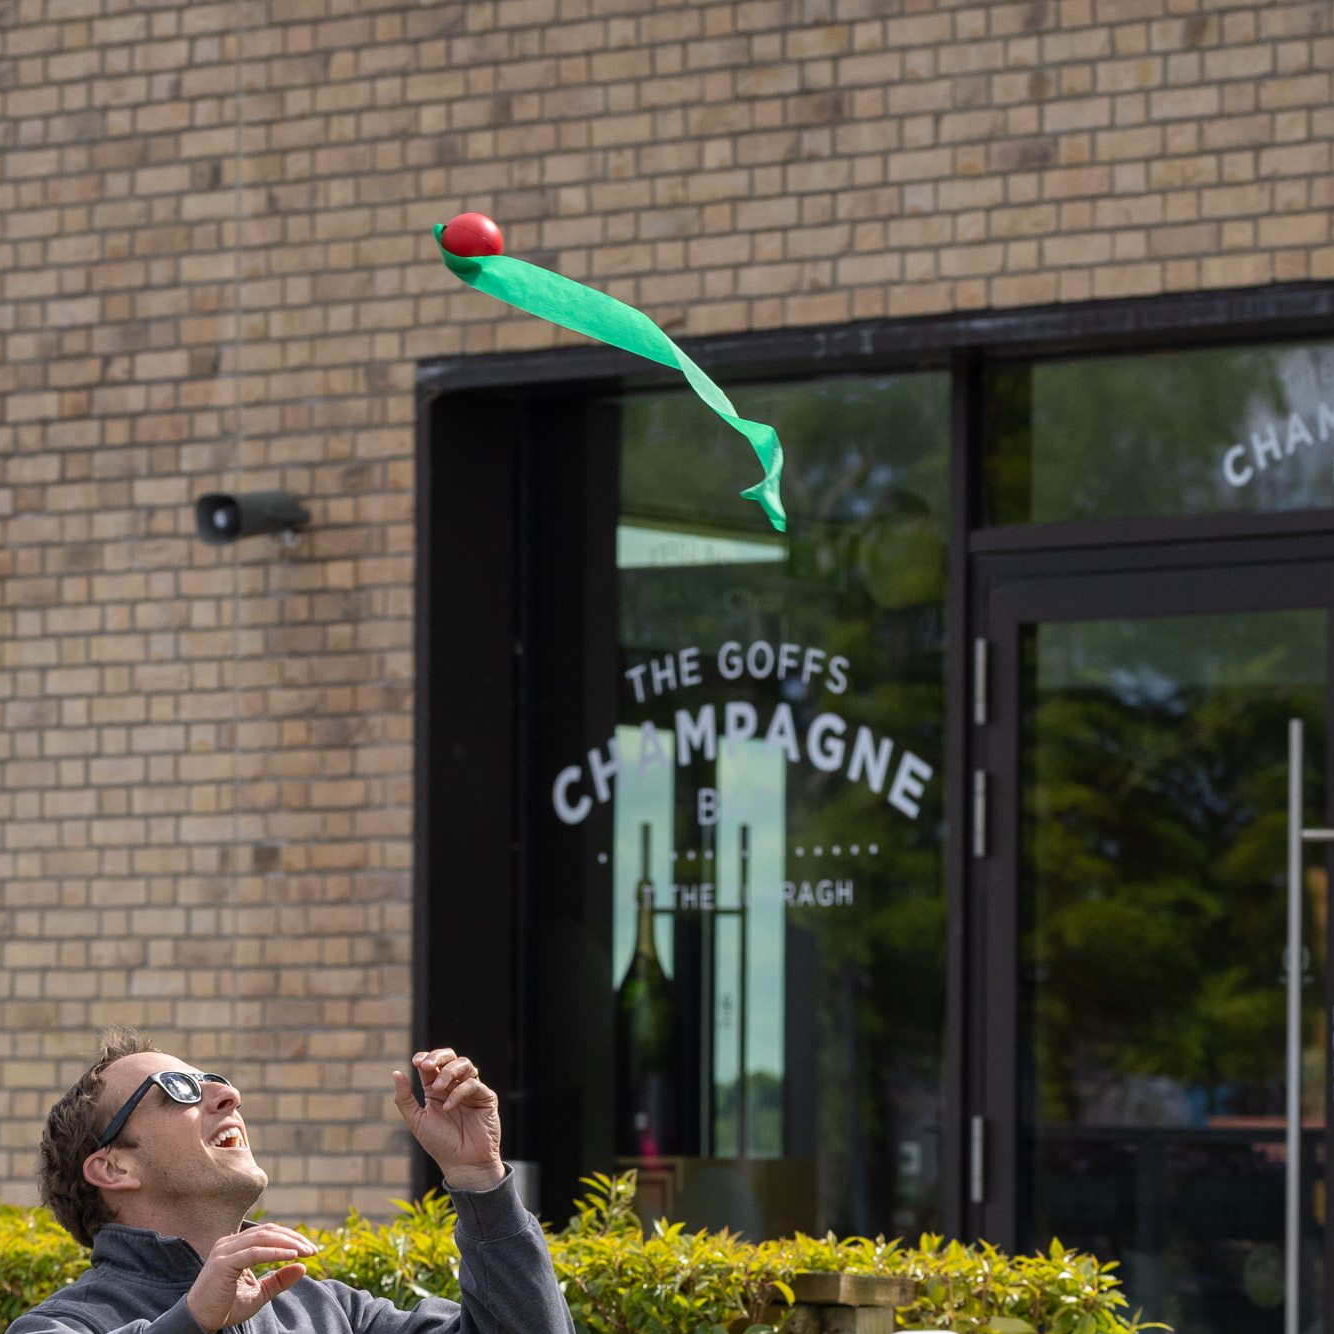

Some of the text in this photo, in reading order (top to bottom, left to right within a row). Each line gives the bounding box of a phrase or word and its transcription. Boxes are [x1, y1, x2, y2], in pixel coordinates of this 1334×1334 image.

[624, 639, 851, 703] THE GOFFS
[552, 701, 934, 826] CHAMPAGNE
[667, 882, 716, 911] THE
